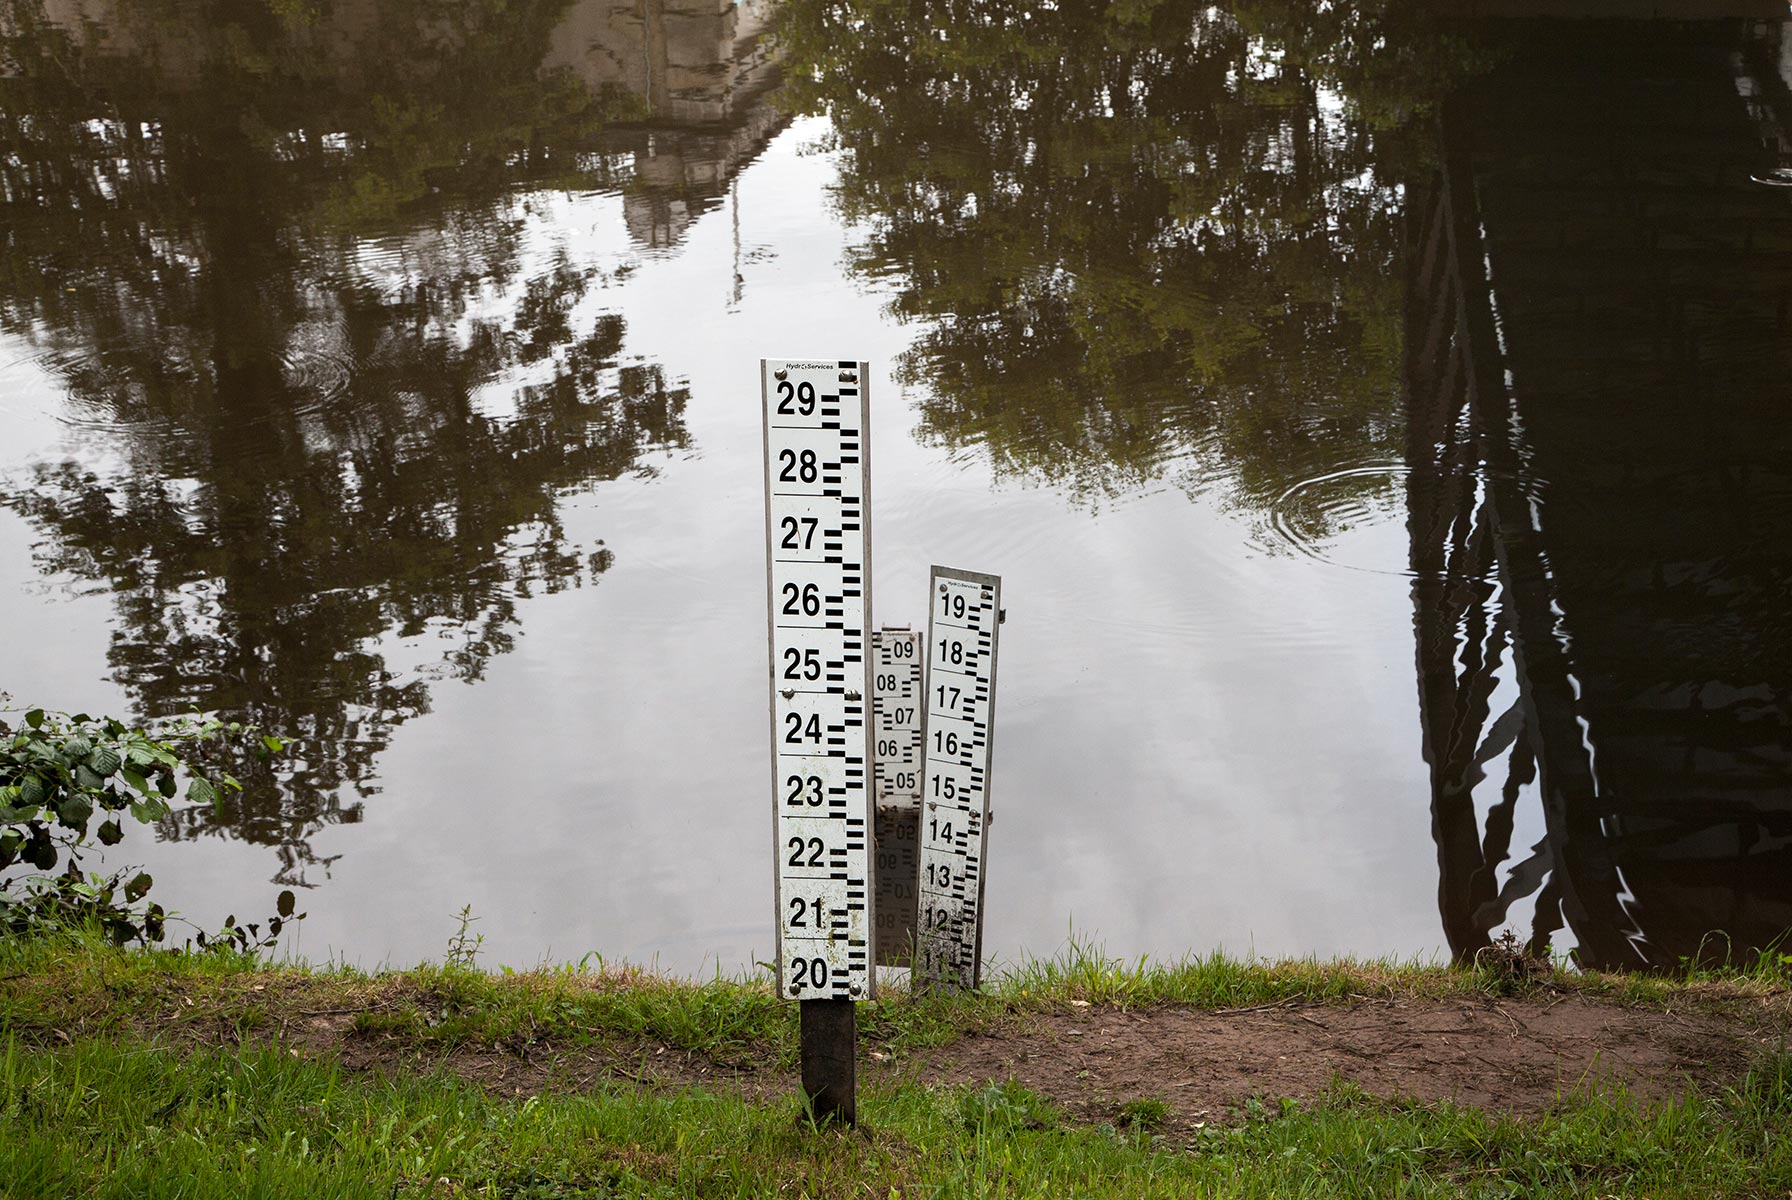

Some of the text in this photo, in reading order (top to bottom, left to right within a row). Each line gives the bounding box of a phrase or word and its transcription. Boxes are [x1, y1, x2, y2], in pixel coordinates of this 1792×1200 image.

[777, 381, 816, 416] 29
[779, 449, 818, 483] 28
[781, 516, 818, 549] 27
[782, 582, 820, 616] 26
[941, 593, 965, 619] 19
[894, 641, 913, 658] 09
[939, 639, 963, 665] 18
[784, 647, 821, 681] 25
[877, 674, 896, 691] 08
[937, 685, 961, 709] 17
[785, 712, 822, 744] 24
[895, 707, 914, 724] 07
[878, 740, 898, 757] 06
[934, 730, 958, 755] 16
[786, 775, 824, 807] 23
[896, 772, 915, 789] 05
[932, 774, 955, 800] 15
[929, 819, 953, 844] 14
[788, 836, 825, 867] 22
[927, 863, 950, 888] 13
[789, 897, 822, 928] 21
[925, 907, 948, 931] 12
[791, 957, 828, 989] 20
